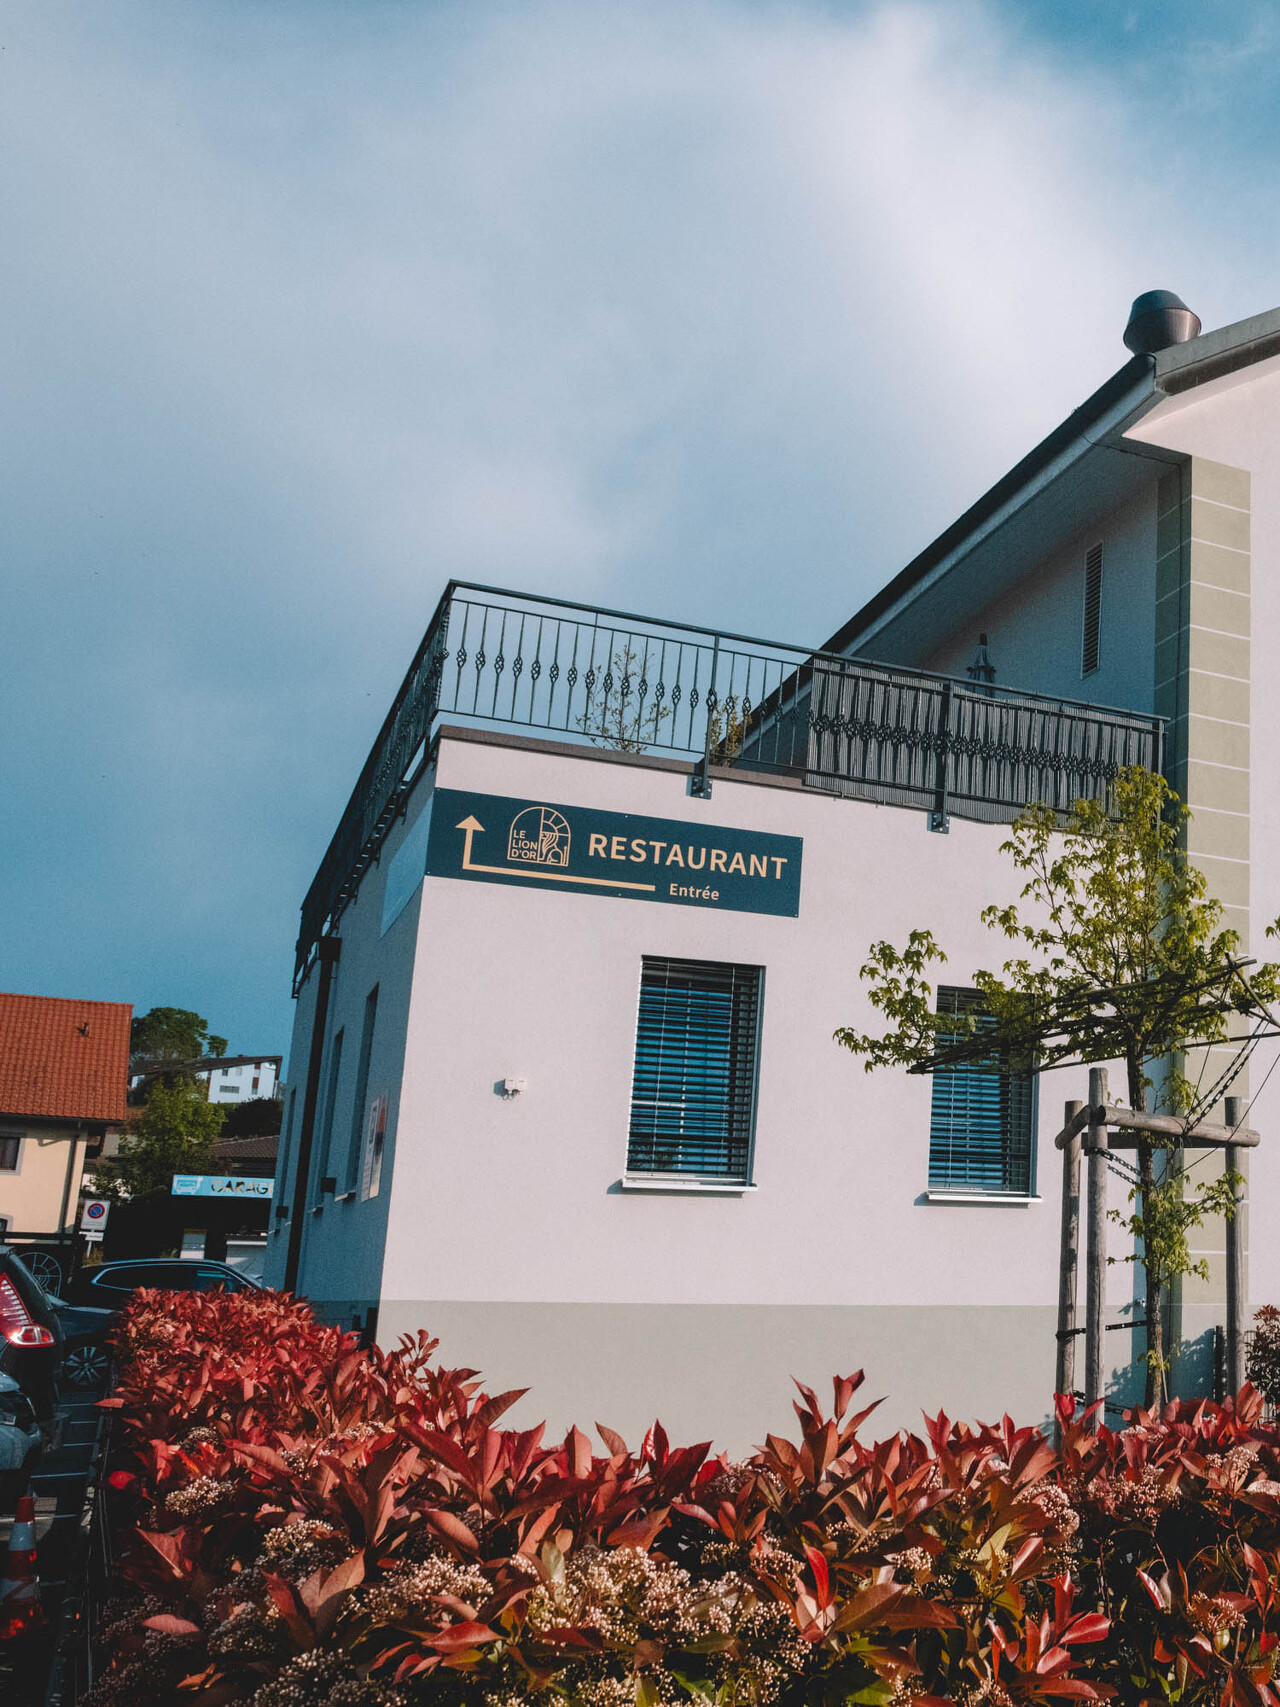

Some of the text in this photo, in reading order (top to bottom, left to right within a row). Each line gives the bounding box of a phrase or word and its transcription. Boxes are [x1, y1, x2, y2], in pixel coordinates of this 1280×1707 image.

[513, 829, 526, 839] LE
[512, 839, 538, 850] LION
[511, 848, 537, 860] D'OR
[588, 832, 788, 880] RESTAURANT
[669, 883, 720, 901] Entrée
